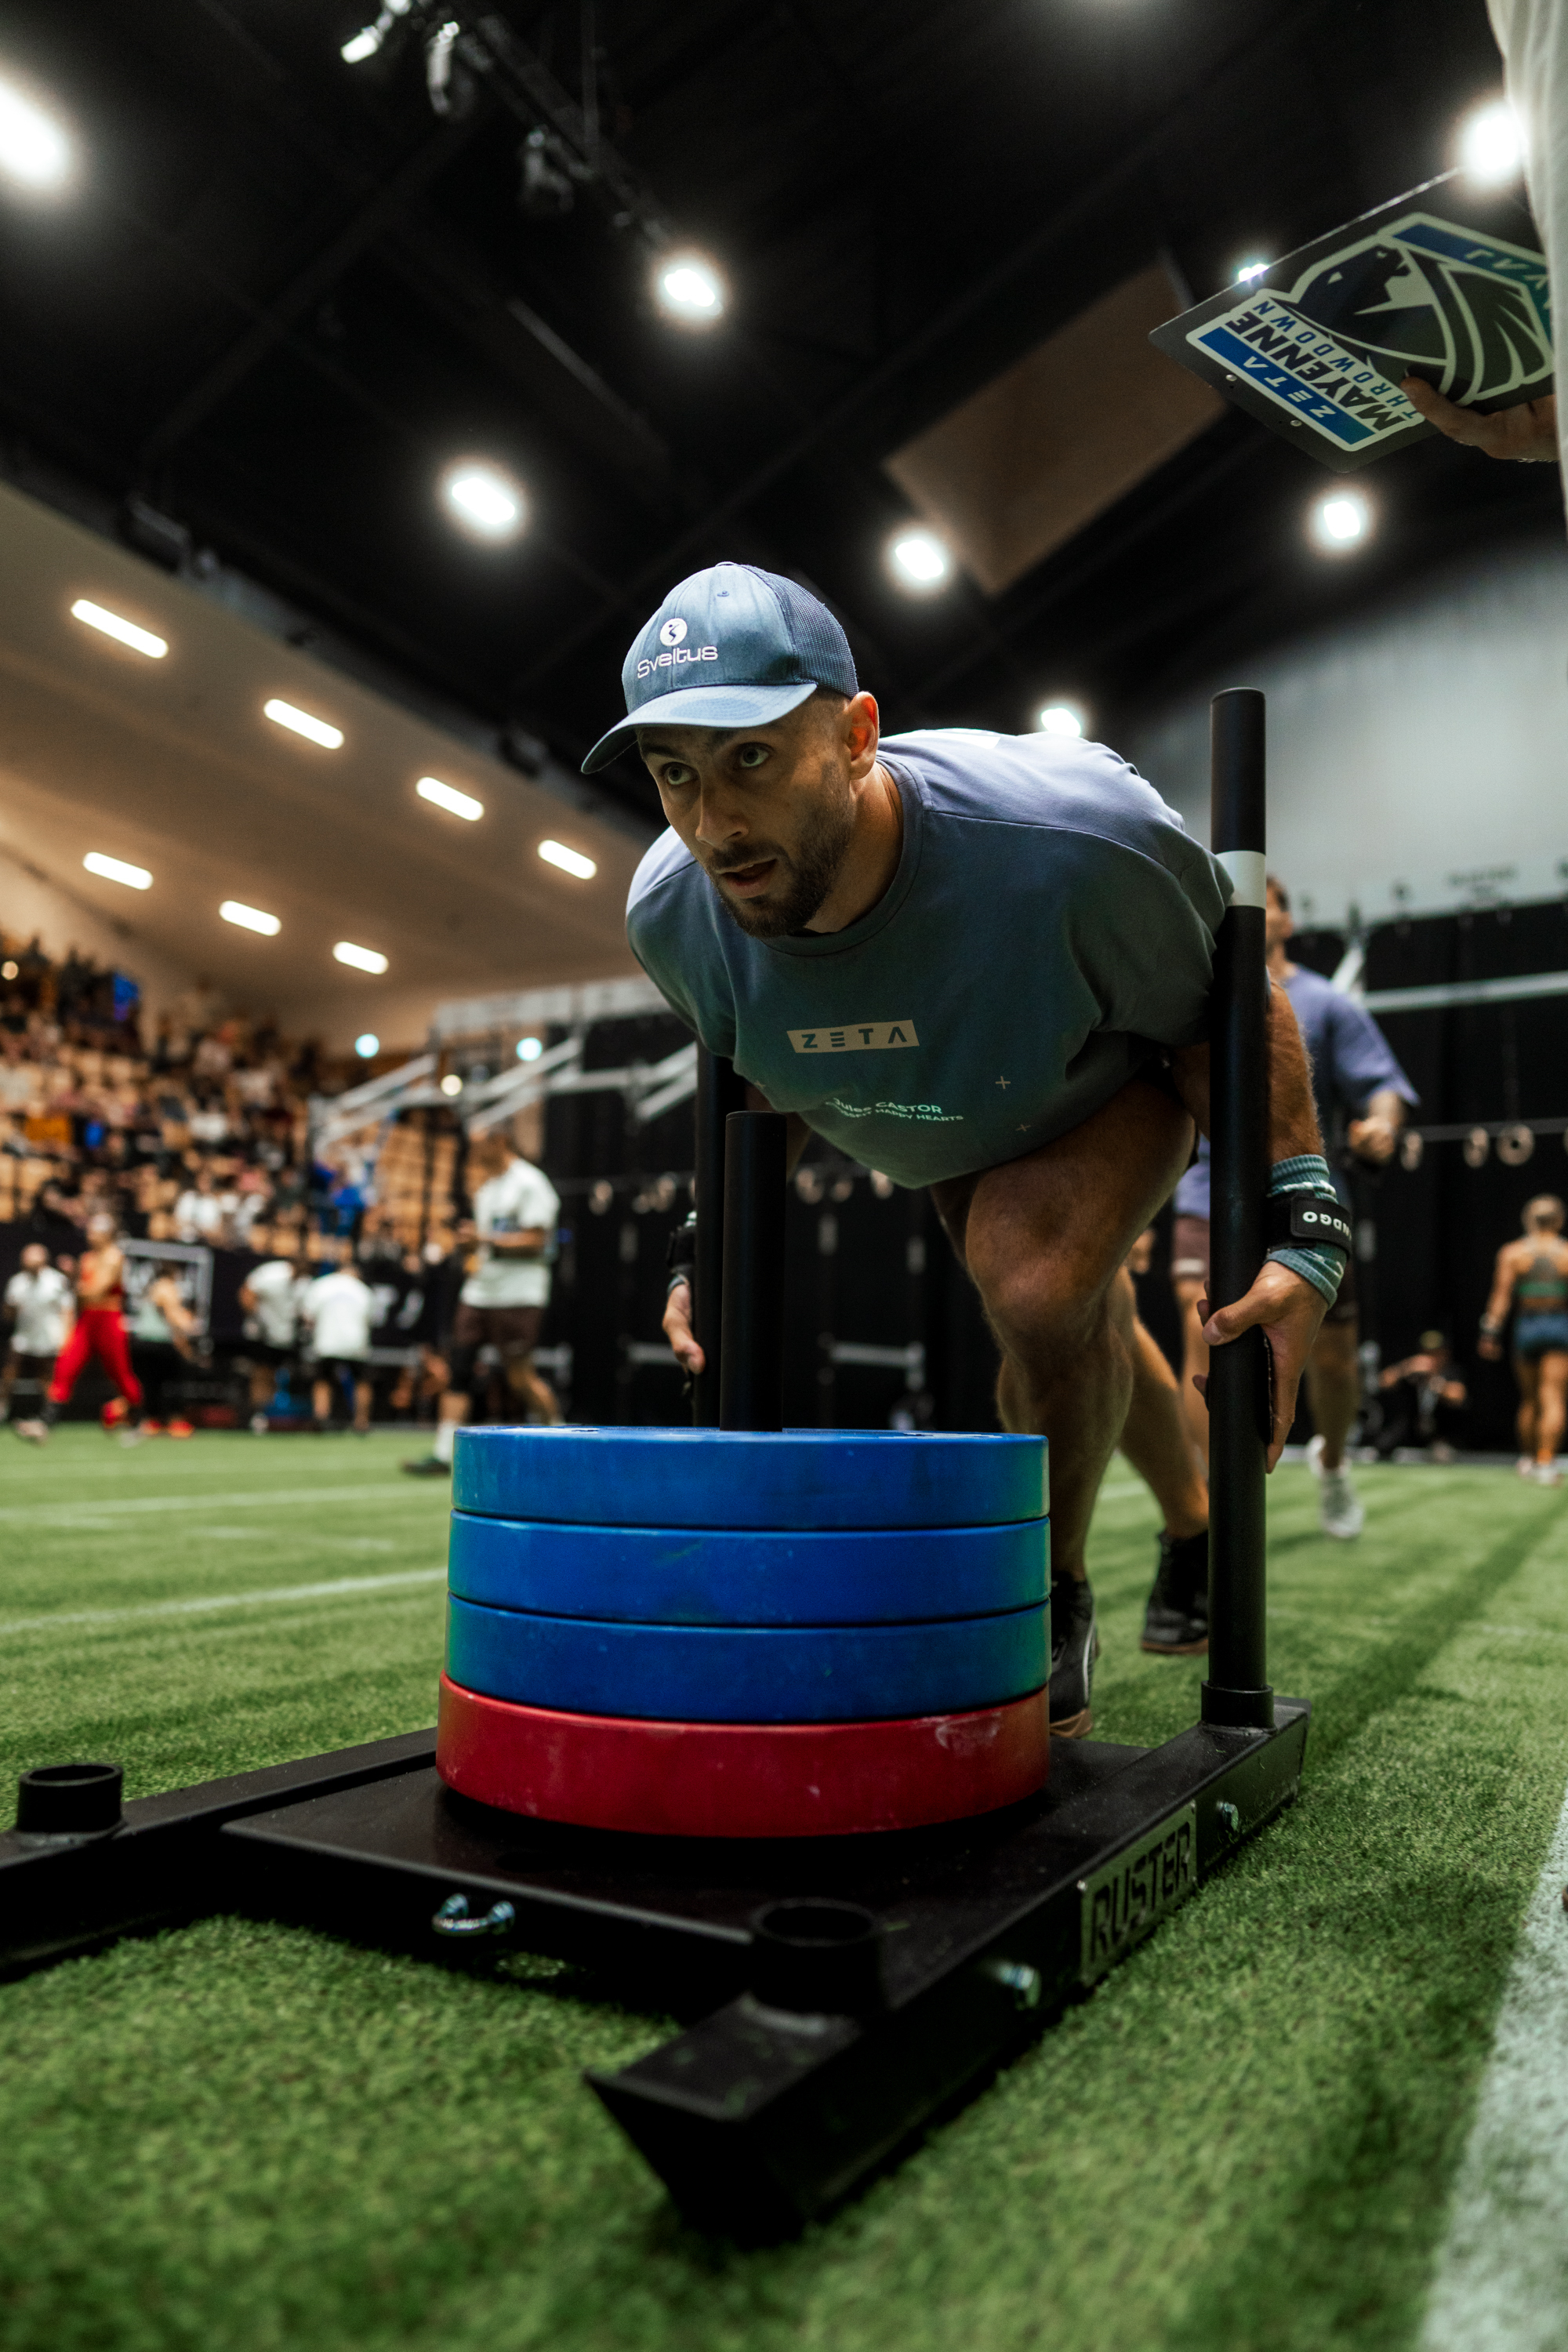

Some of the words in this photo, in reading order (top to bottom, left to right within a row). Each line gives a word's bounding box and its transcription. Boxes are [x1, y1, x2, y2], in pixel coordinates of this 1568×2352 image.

[1225, 312, 1406, 431] MAYENNE
[1252, 300, 1419, 419] THROWDOWN
[1243, 355, 1336, 418] ZETA
[637, 646, 718, 679] Sveltus
[801, 1026, 907, 1048] ZETA
[875, 1102, 943, 1114] CASTOR
[875, 1109, 913, 1119] HAPPY
[1302, 1210, 1352, 1241] NDGO
[1091, 1821, 1190, 1962] RUSTER
